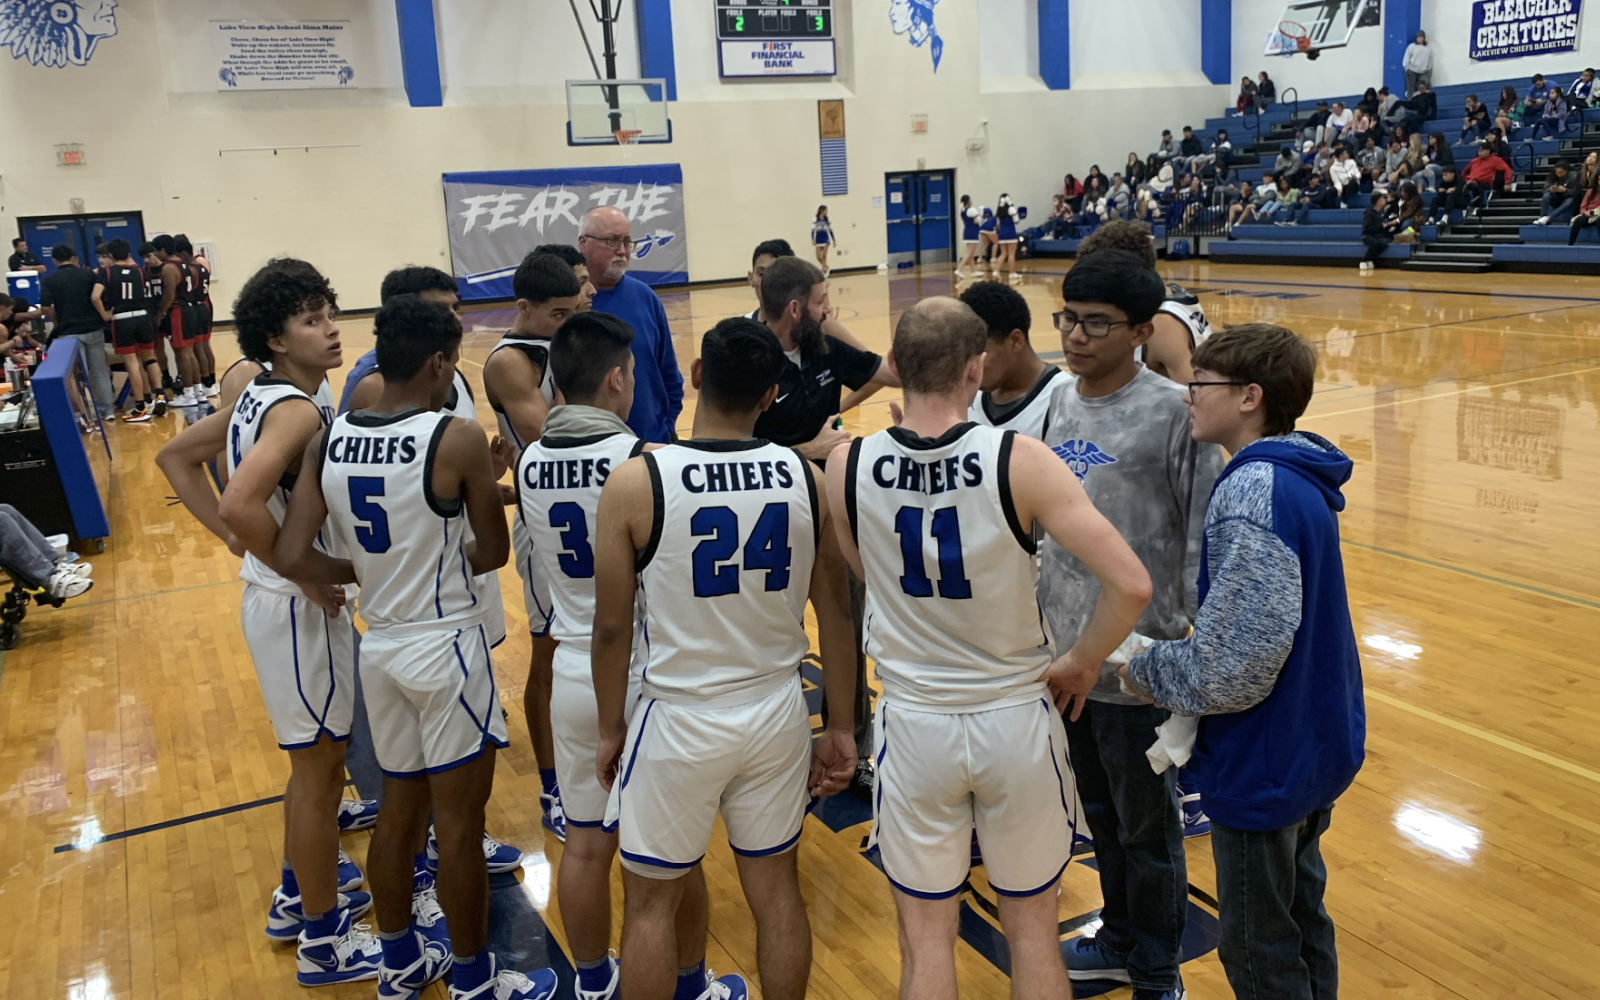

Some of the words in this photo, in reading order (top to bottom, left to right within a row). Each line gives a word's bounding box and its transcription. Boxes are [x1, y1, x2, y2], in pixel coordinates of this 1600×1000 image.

[736, 16, 744, 32] 2
[814, 16, 824, 31] 3
[1477, 14, 1577, 49] CREATURES
[751, 52, 804, 60] FINANCIAL
[762, 42, 792, 50] FIRST
[1472, 46, 1508, 58] LAKEVIEW
[1510, 44, 1534, 54] CHIEFS
[1534, 39, 1575, 50] BASKETBAL
[458, 184, 581, 238] FEAR
[588, 179, 676, 224] THE
[122, 282, 132, 300] 11
[328, 436, 416, 464] CHIEFS
[524, 458, 610, 490] CHIEFS
[681, 461, 794, 494] CHIEFS
[872, 452, 983, 496] CHIEFS
[348, 476, 392, 554] 5
[548, 502, 595, 578] 3
[690, 502, 792, 598] 24
[895, 505, 973, 600] 11
